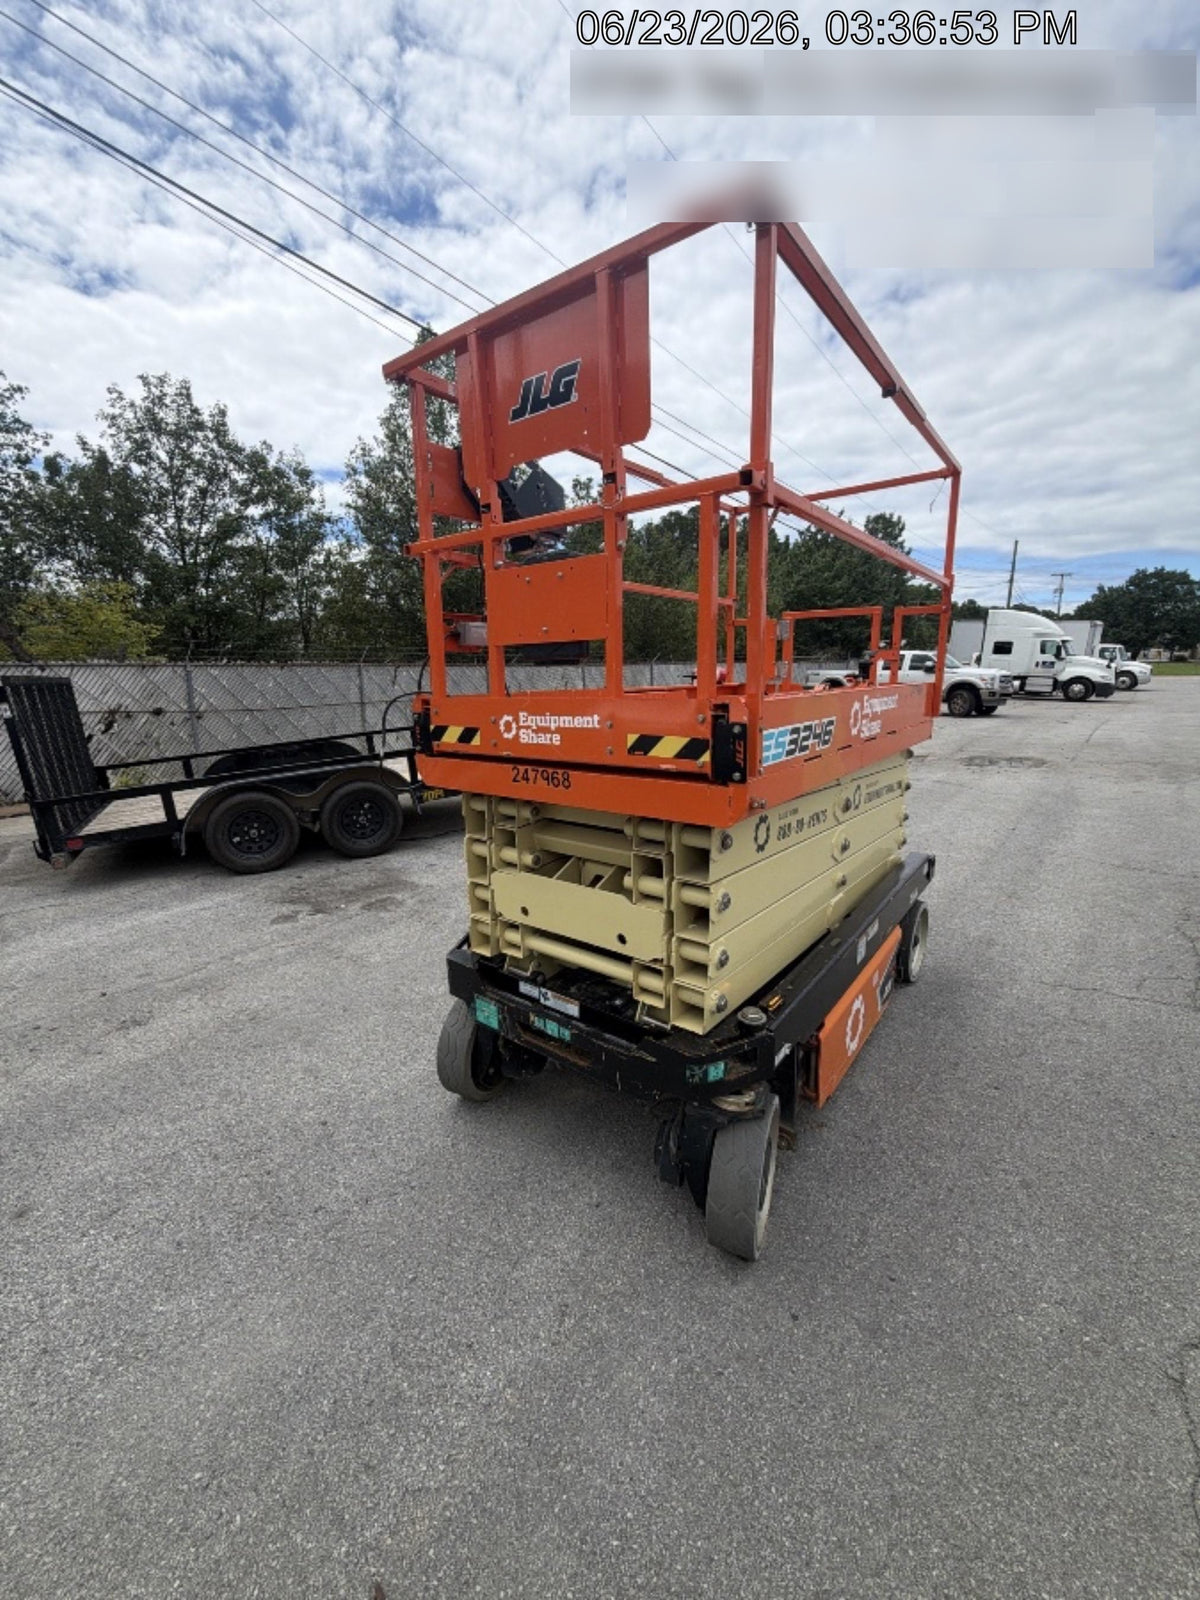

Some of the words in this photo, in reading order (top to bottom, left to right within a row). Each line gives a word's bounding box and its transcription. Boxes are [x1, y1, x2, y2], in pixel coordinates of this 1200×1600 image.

[508, 357, 582, 425] JLG
[862, 694, 898, 717] Equipment
[518, 711, 601, 731] Equipment
[518, 728, 561, 746] Share
[762, 718, 836, 765] ES3246
[511, 765, 572, 791] 247968
